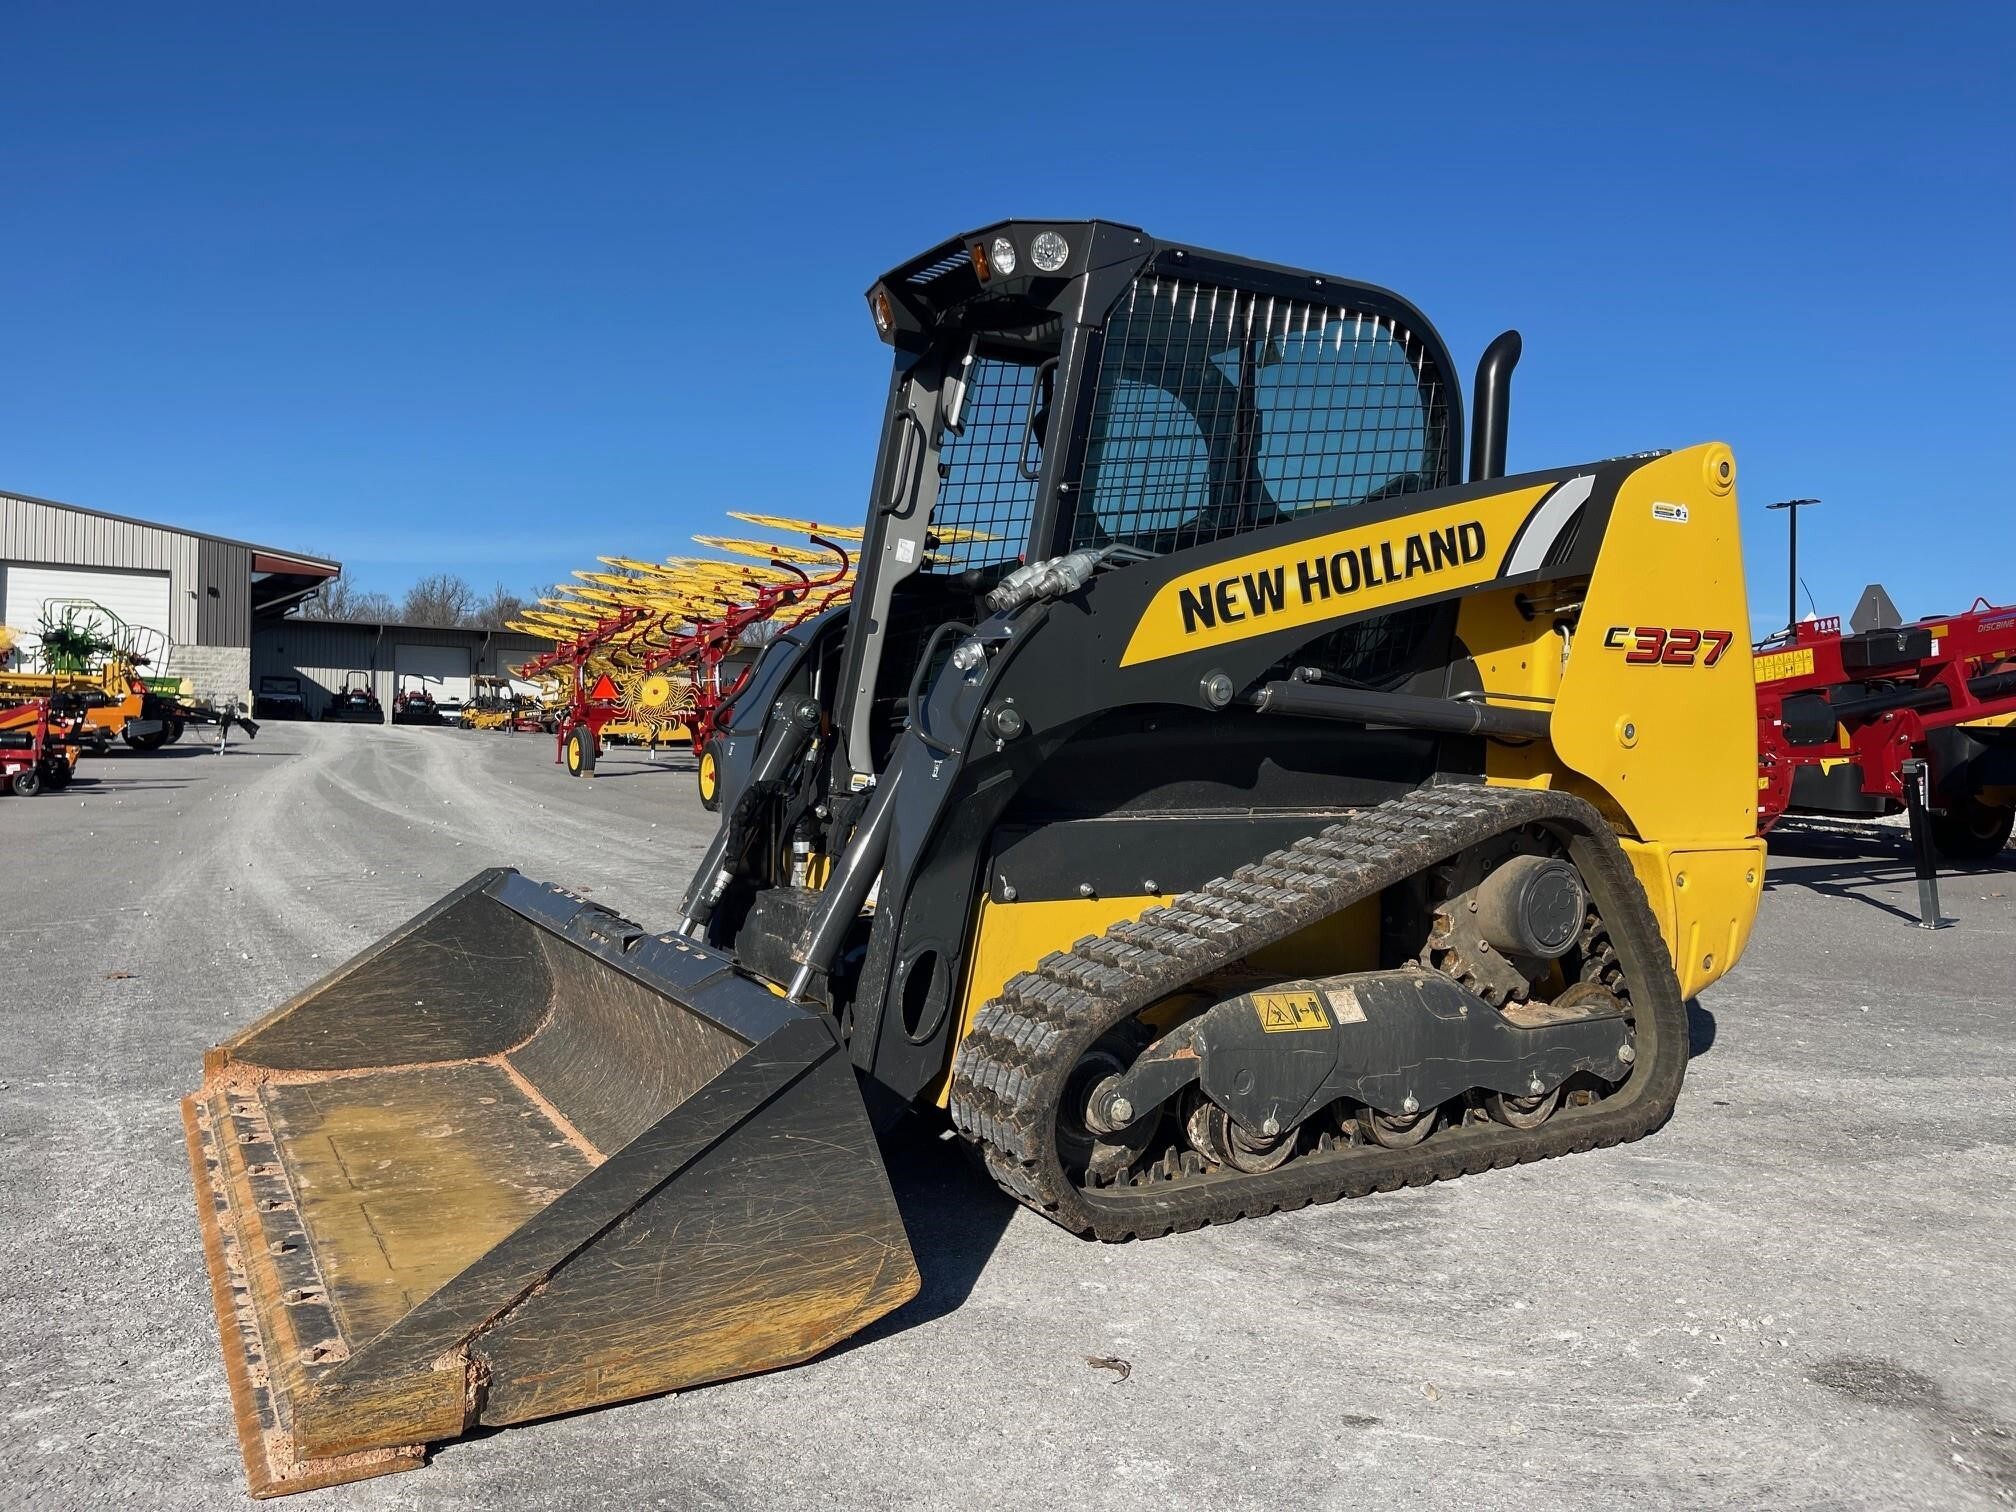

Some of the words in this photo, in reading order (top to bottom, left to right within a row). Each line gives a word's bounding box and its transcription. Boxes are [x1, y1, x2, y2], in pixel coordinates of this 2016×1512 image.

[1178, 564, 1285, 635] NEW
[1296, 520, 1487, 605] HOLLAND
[1977, 619, 2015, 632] DISCBINE
[1603, 626, 1733, 666] C327
